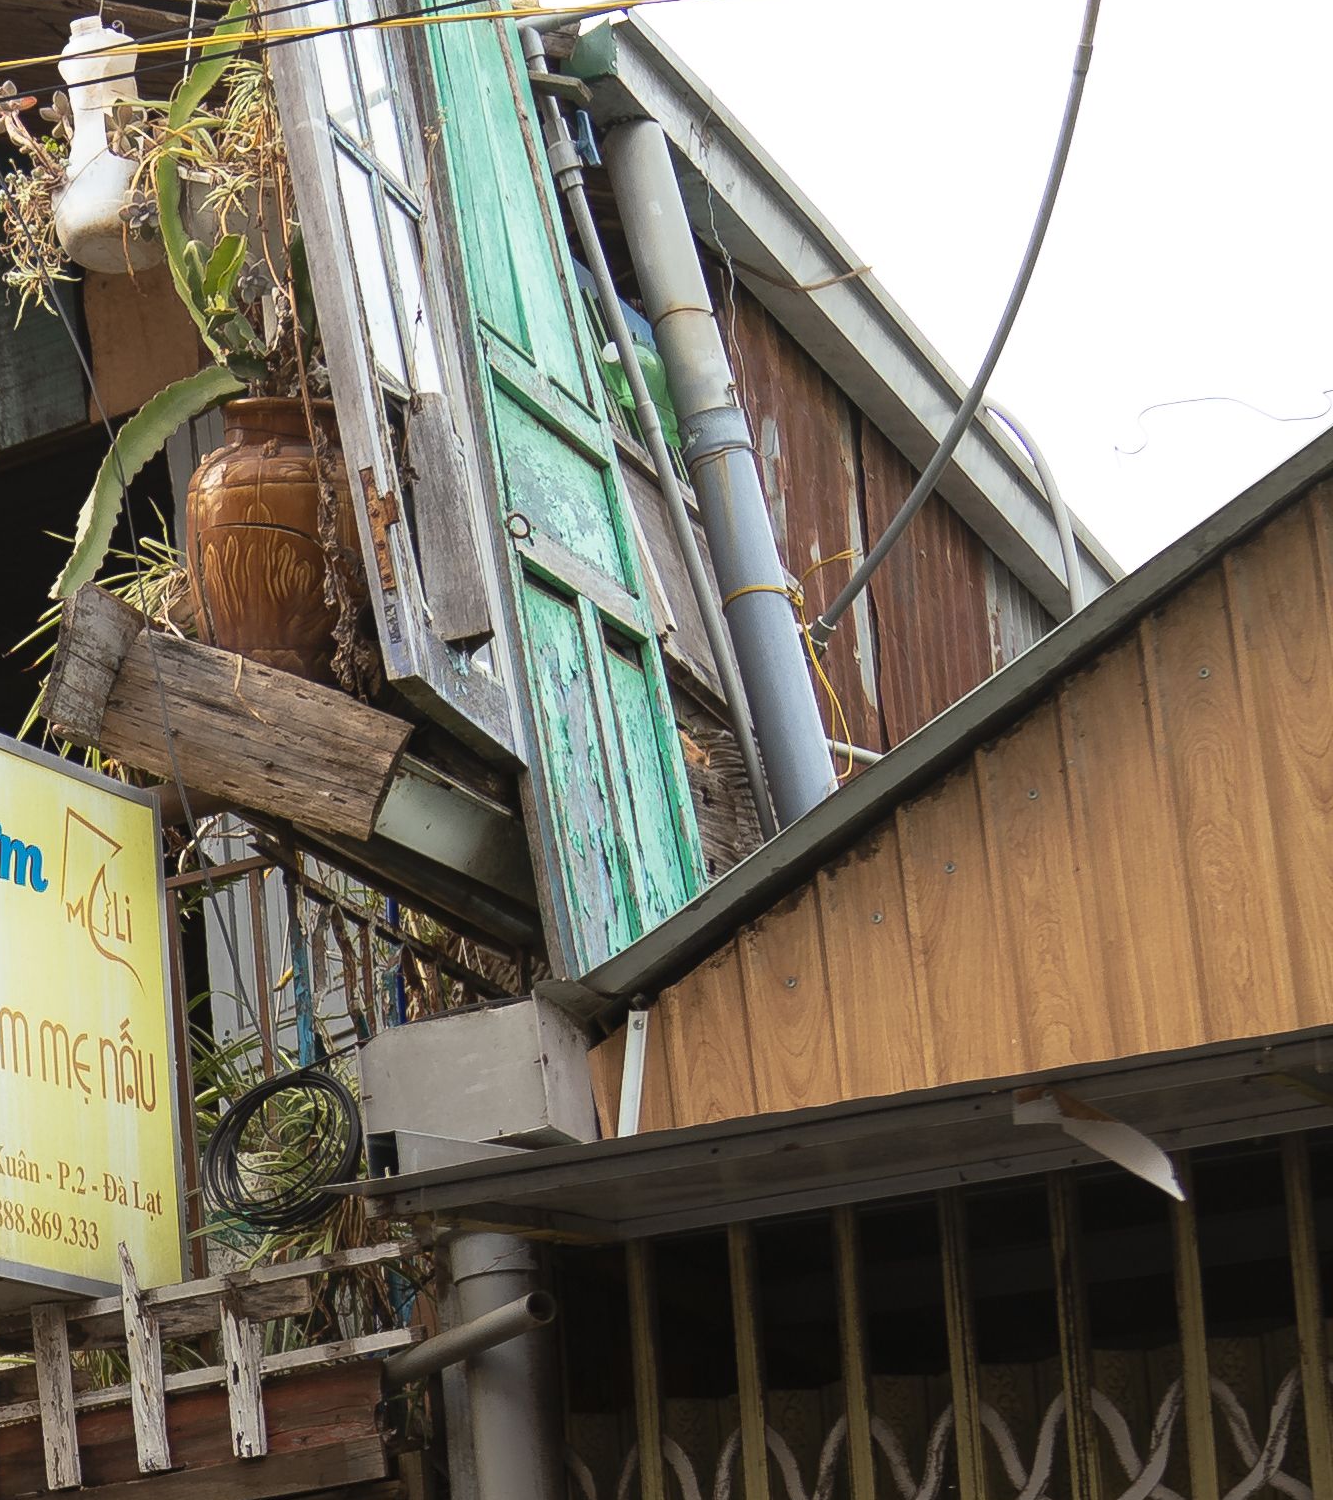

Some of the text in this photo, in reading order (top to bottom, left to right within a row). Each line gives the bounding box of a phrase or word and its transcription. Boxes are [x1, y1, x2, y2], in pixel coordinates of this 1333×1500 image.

[57, 1160, 87, 1196] P.2
[102, 1171, 129, 1206] Đà
[134, 1180, 164, 1222] Lạt
